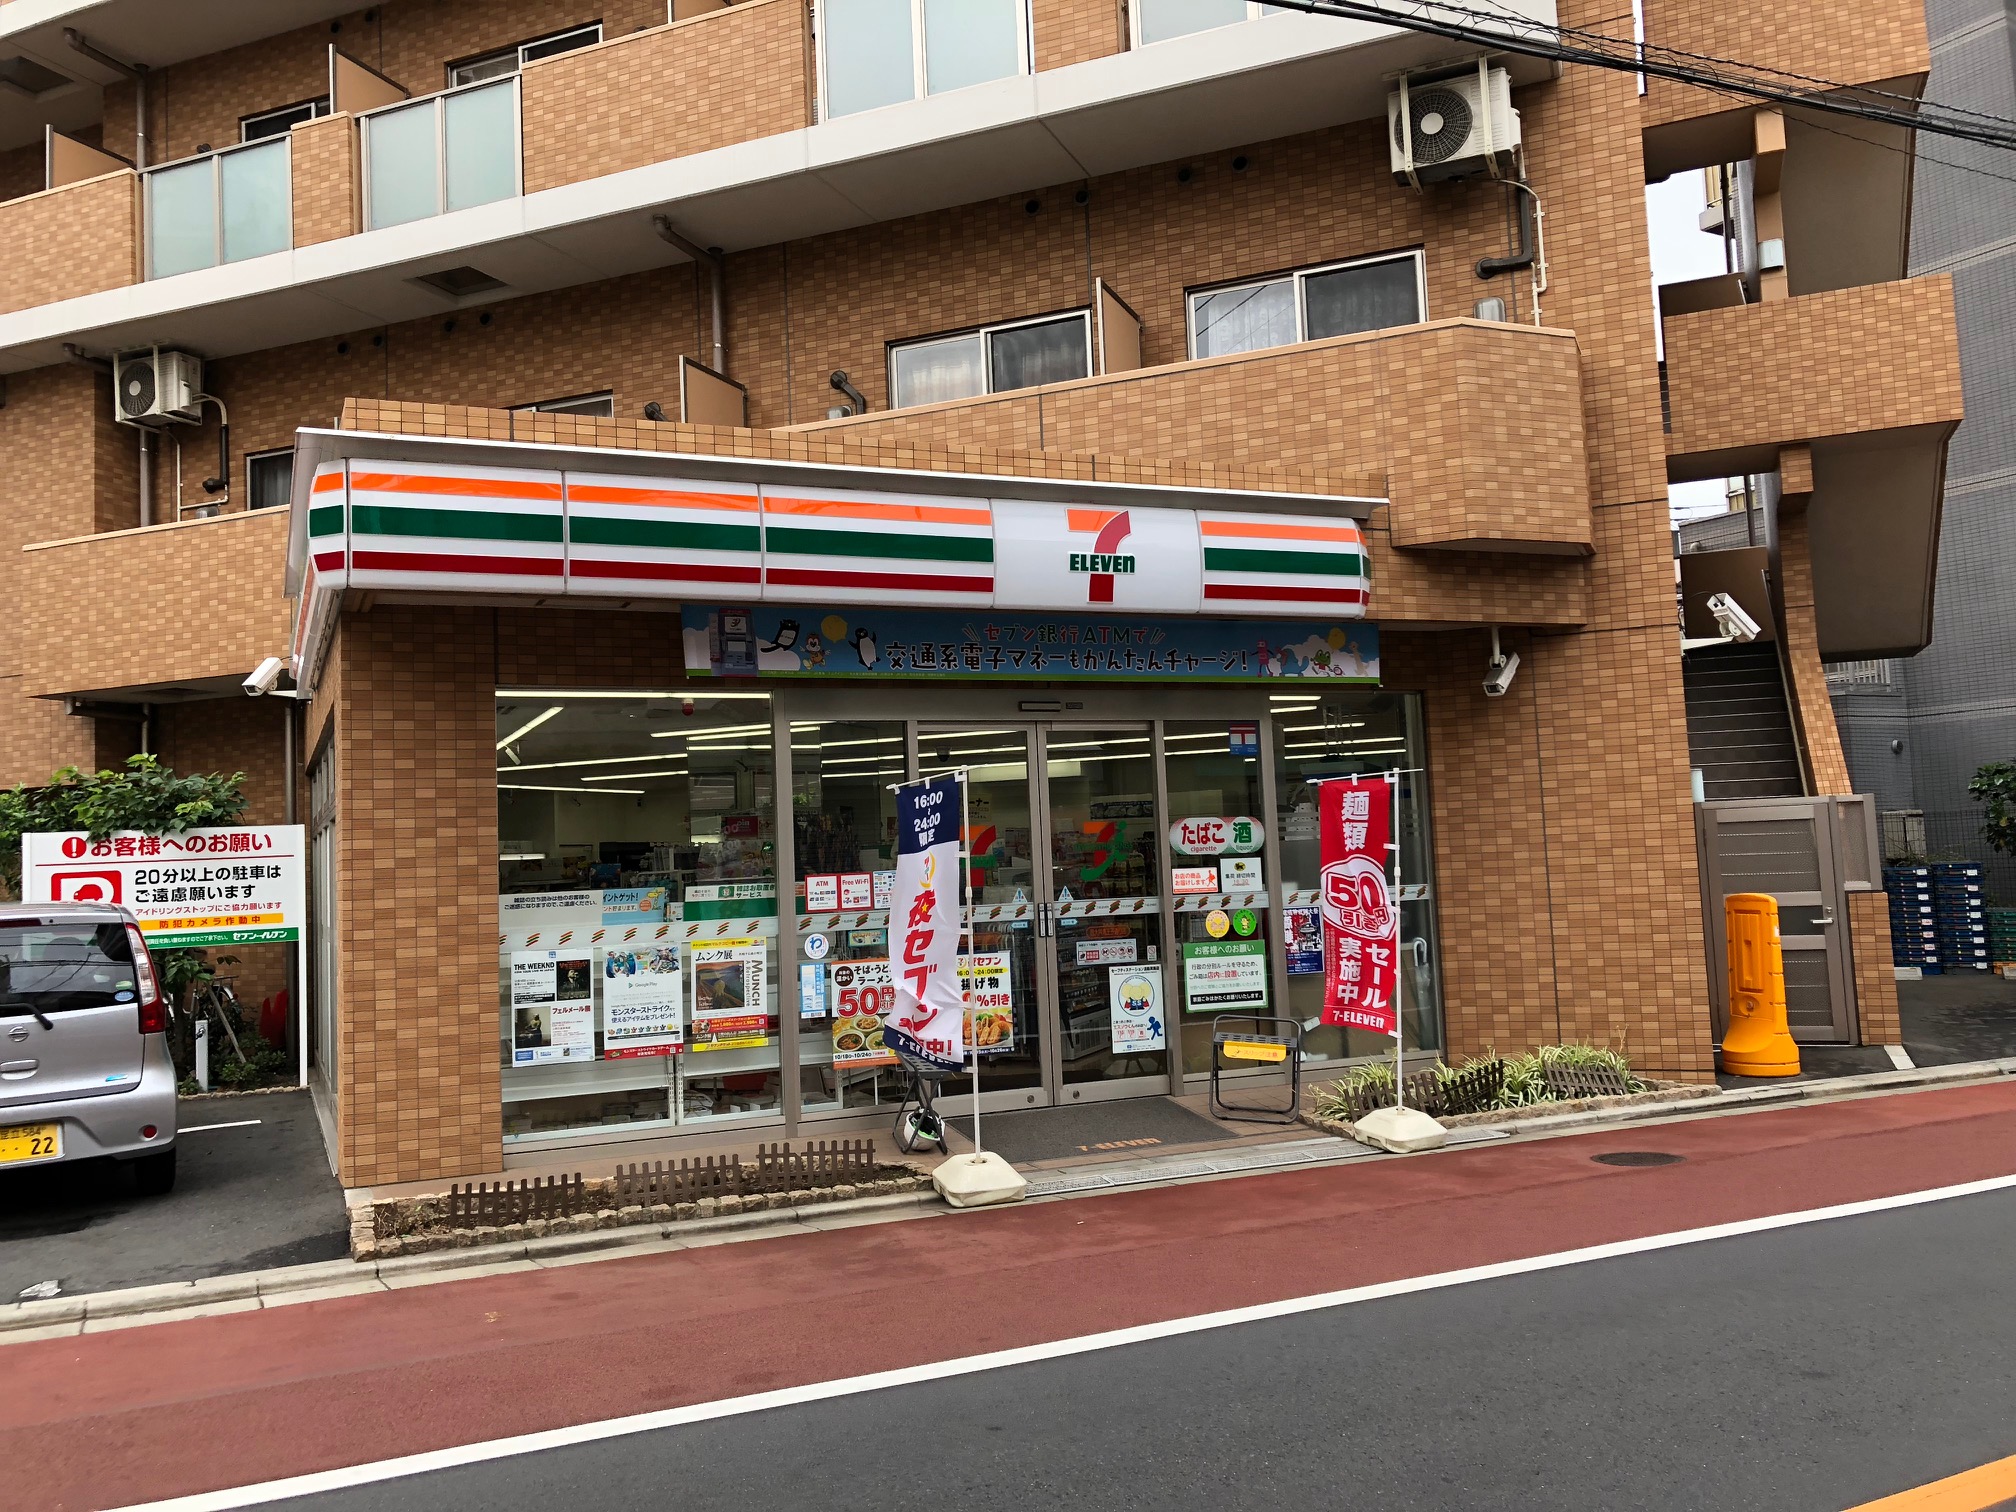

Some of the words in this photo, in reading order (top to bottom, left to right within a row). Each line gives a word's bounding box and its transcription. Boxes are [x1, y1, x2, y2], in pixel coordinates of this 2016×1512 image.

[914, 791, 943, 810] 16:00
[914, 812, 941, 832] 24:00
[1341, 791, 1370, 852] 麺類
[1181, 822, 1225, 845] たばこ
[1233, 822, 1252, 843] 酒
[90, 832, 272, 857] お客様へのお願い
[135, 865, 282, 885] 20分以上の駐車は
[135, 885, 256, 903] ご遠慮願います
[135, 902, 282, 916] アイドリングストップにご協力願います
[159, 915, 261, 929] 防犯カメラ作動中
[695, 950, 733, 961] ムンク展
[1194, 943, 1255, 955] お客様へのお願い
[854, 964, 892, 974] そば・うど
[1337, 936, 1362, 1005] 実施中
[1361, 942, 1391, 1009] セール
[751, 960, 763, 1007] MUNCH
